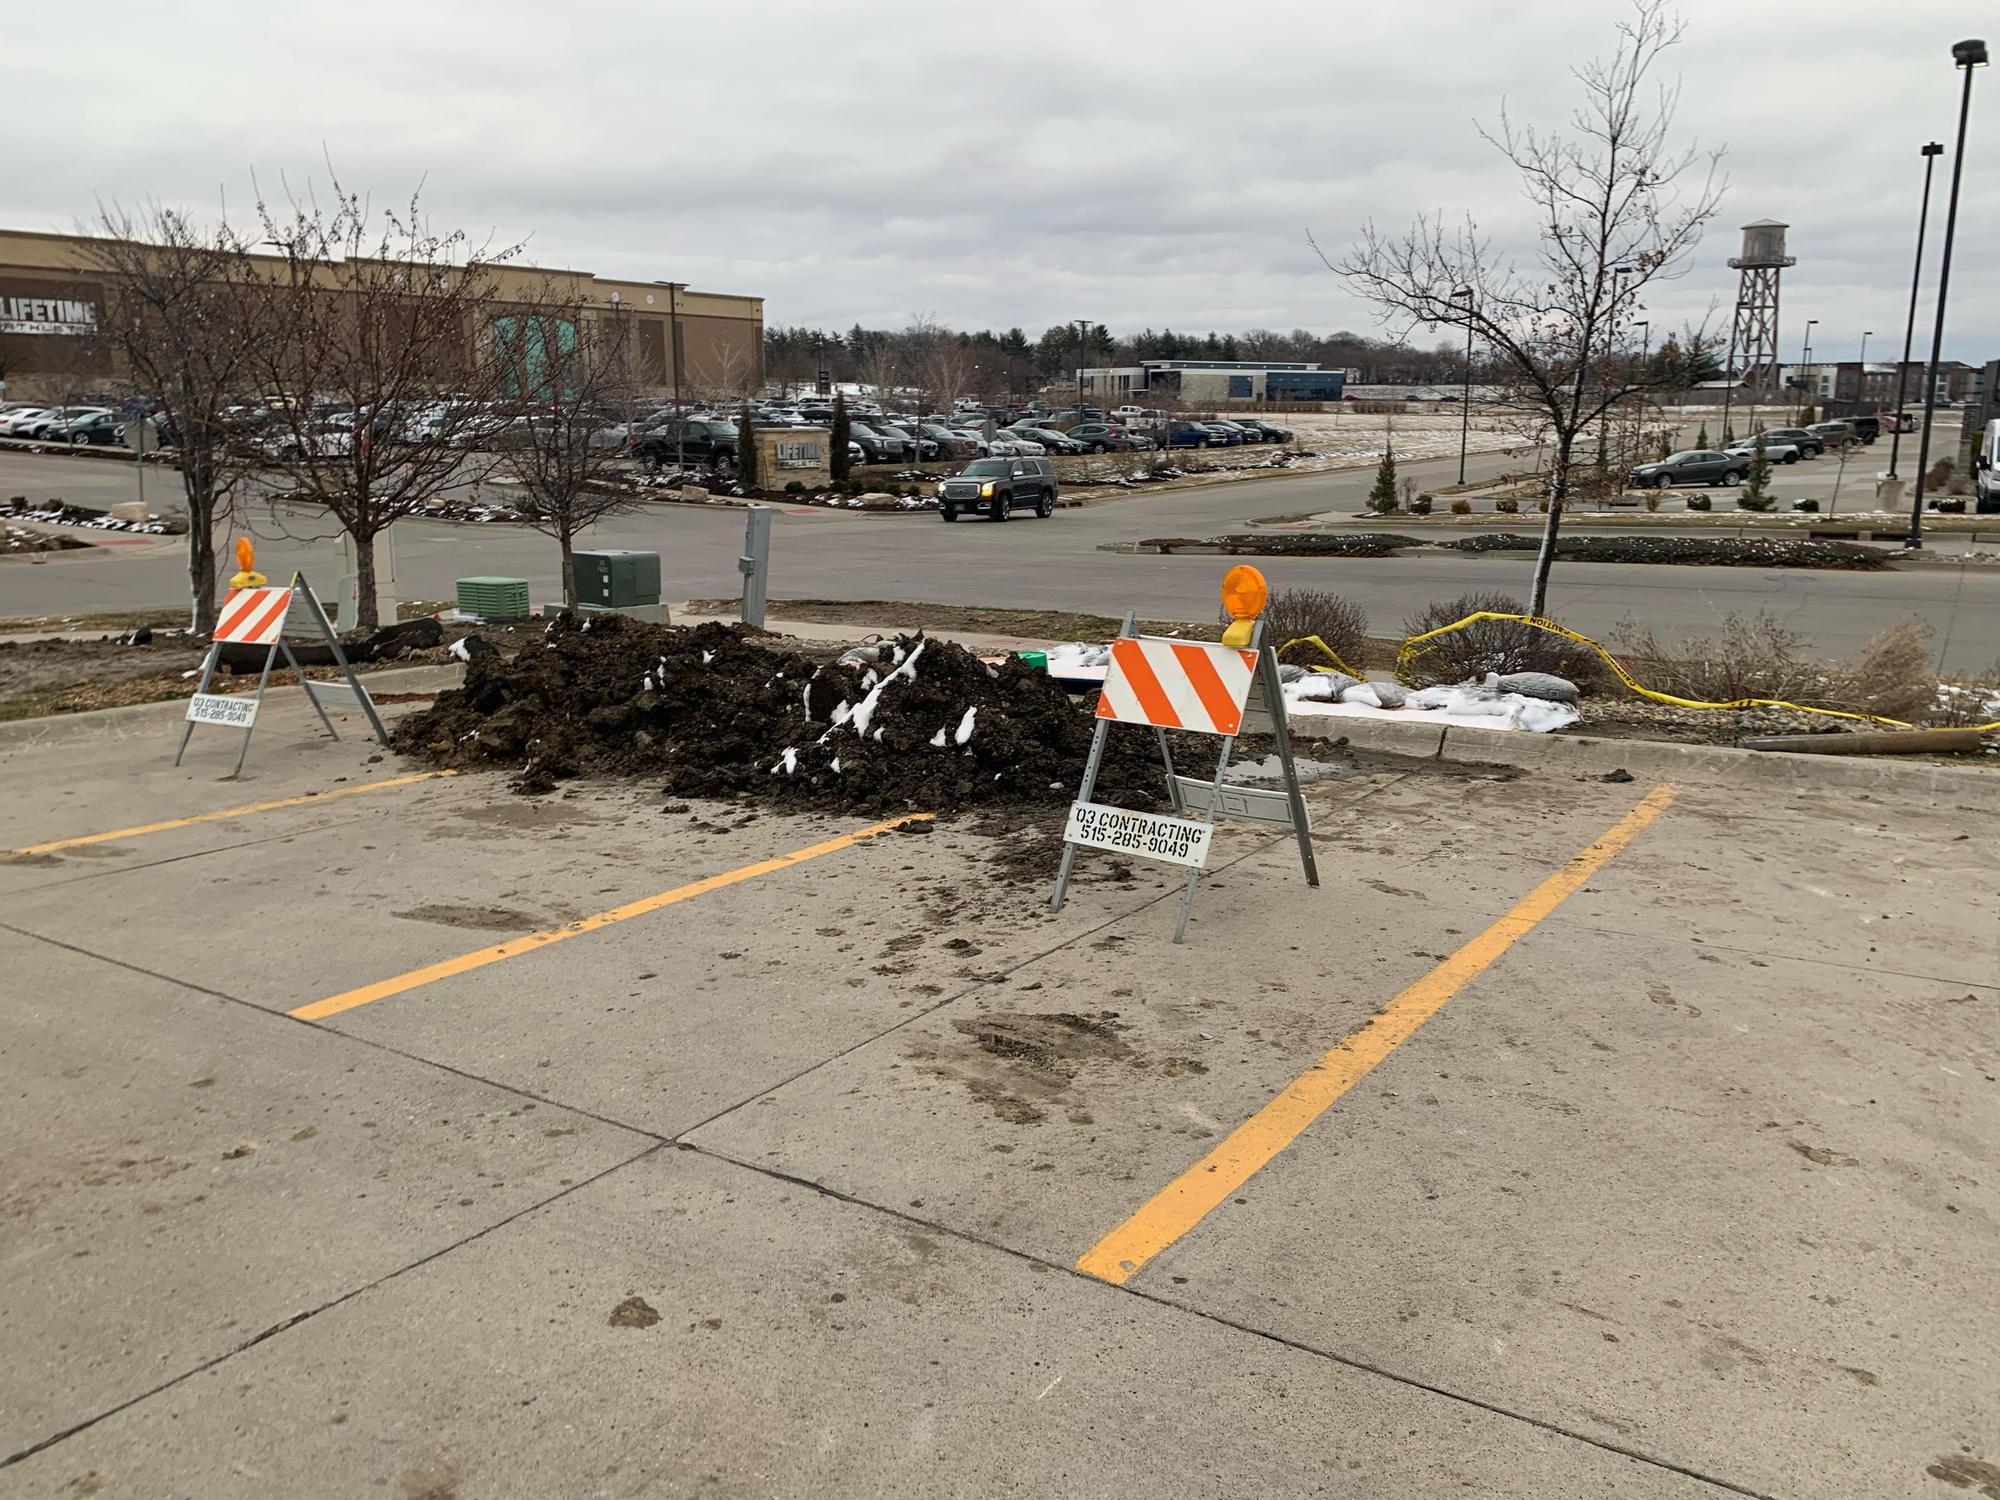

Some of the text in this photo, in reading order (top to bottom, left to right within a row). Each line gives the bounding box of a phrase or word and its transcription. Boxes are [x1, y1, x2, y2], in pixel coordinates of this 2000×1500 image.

[1530, 617, 1570, 635] CAUTION
[205, 699, 254, 712] CONTRACTING
[1099, 812, 1202, 844] CONTRACTING
[1080, 824, 1189, 858] 515-285-9049
